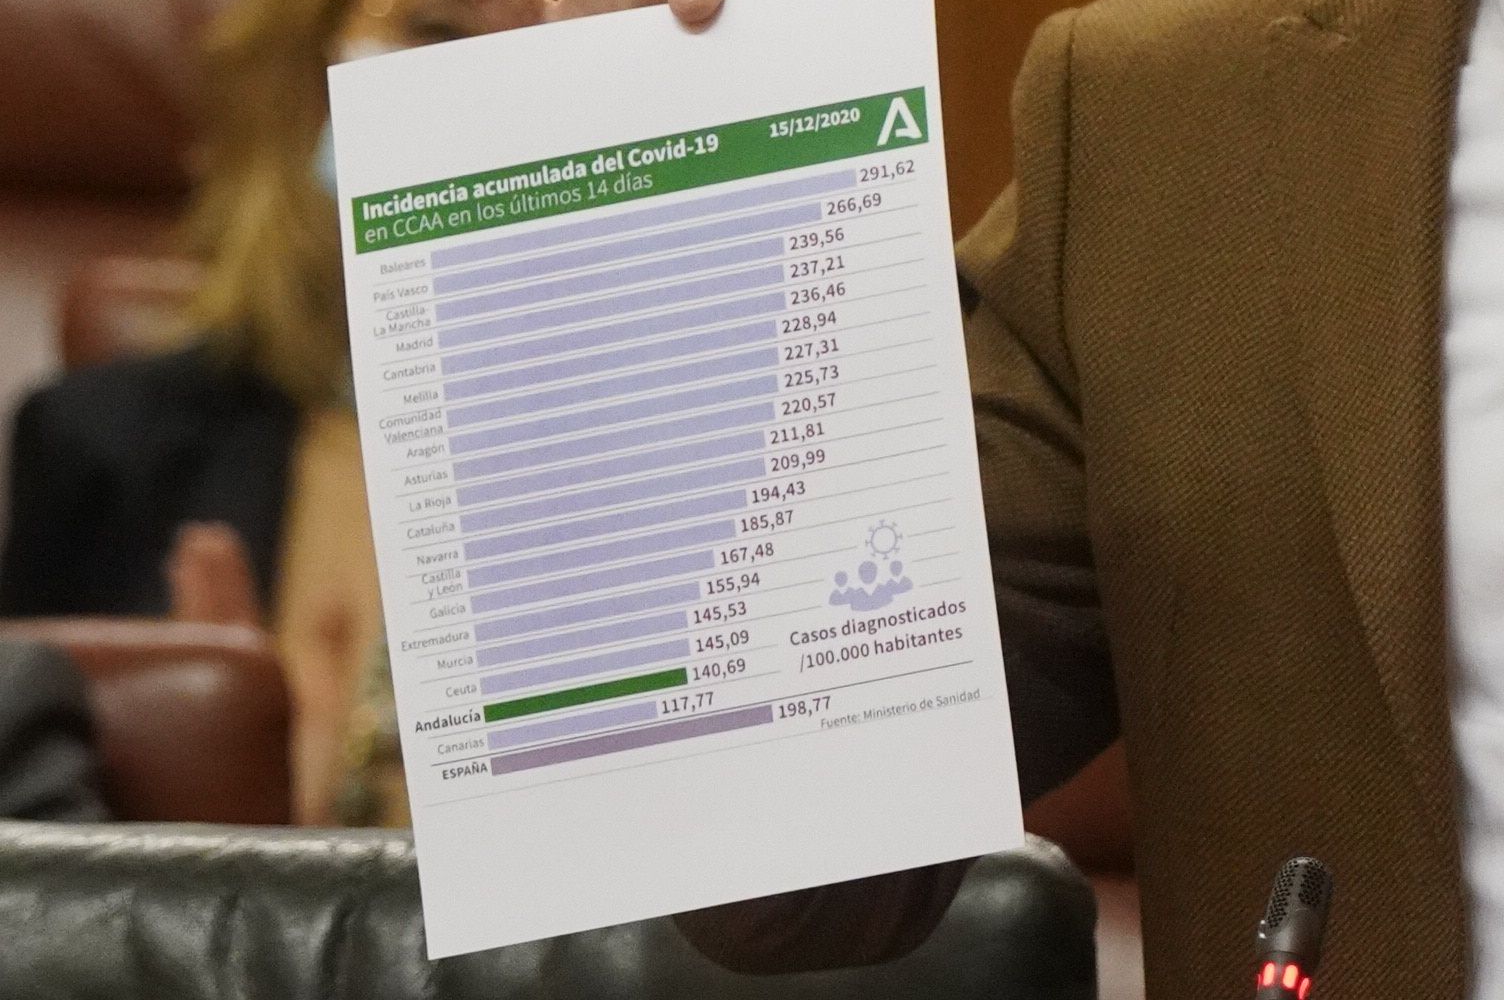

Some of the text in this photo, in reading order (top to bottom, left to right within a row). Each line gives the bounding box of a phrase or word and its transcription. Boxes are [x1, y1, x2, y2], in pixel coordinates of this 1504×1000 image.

[769, 107, 861, 139] 15/12/2020
[362, 133, 719, 221] Incidencia acumulada del Covid-19
[860, 159, 915, 182] 291,62
[364, 172, 653, 244] en CCAA en los últimos 14 días
[827, 192, 882, 215] 266,69
[789, 227, 845, 251] 239,56
[380, 259, 426, 274] Baleares
[790, 255, 845, 278] 237,21
[397, 285, 428, 298] Vasco
[790, 282, 846, 305] 236,46
[373, 318, 431, 337] La Mancha
[782, 311, 837, 333] 228,94
[396, 337, 433, 352] Madrid
[784, 339, 839, 361] 227,31
[383, 363, 436, 380] Cantabria
[784, 364, 840, 388] 225,73
[403, 390, 439, 404] Melilla
[781, 392, 836, 415] 220,57
[379, 409, 441, 429] Comunidad
[384, 425, 443, 443] Valenciana
[770, 422, 825, 445] 211,81
[407, 443, 445, 458] Aragón
[771, 449, 826, 472] 209,99
[404, 471, 448, 486] Asturias
[409, 496, 452, 512] La Rioja
[752, 481, 806, 504] 194,43
[407, 522, 455, 539] Cataluña
[741, 510, 794, 533] 185,87
[417, 551, 459, 565] Navarra
[720, 542, 775, 565] 167,48
[422, 568, 461, 584] Castilla
[707, 572, 760, 595] 155,94
[428, 583, 463, 599] y León
[430, 604, 466, 619] Galicia
[693, 601, 747, 624] 145,53
[790, 600, 967, 646] Casos diagnosticados
[401, 630, 469, 651] Extremadura
[696, 630, 750, 653] 145,09
[799, 626, 963, 672] /100.000 habitantes
[437, 656, 474, 669] Murcia
[692, 658, 746, 681] 140,69
[445, 684, 477, 697] Ceuta
[661, 691, 714, 714] 117,77
[778, 696, 831, 719] 198,77
[820, 689, 981, 729] Fuente: Ministerio de Sanidad
[415, 709, 481, 732] Andalucía
[437, 738, 485, 754] Canarias
[442, 762, 488, 780] ESPAÑA
